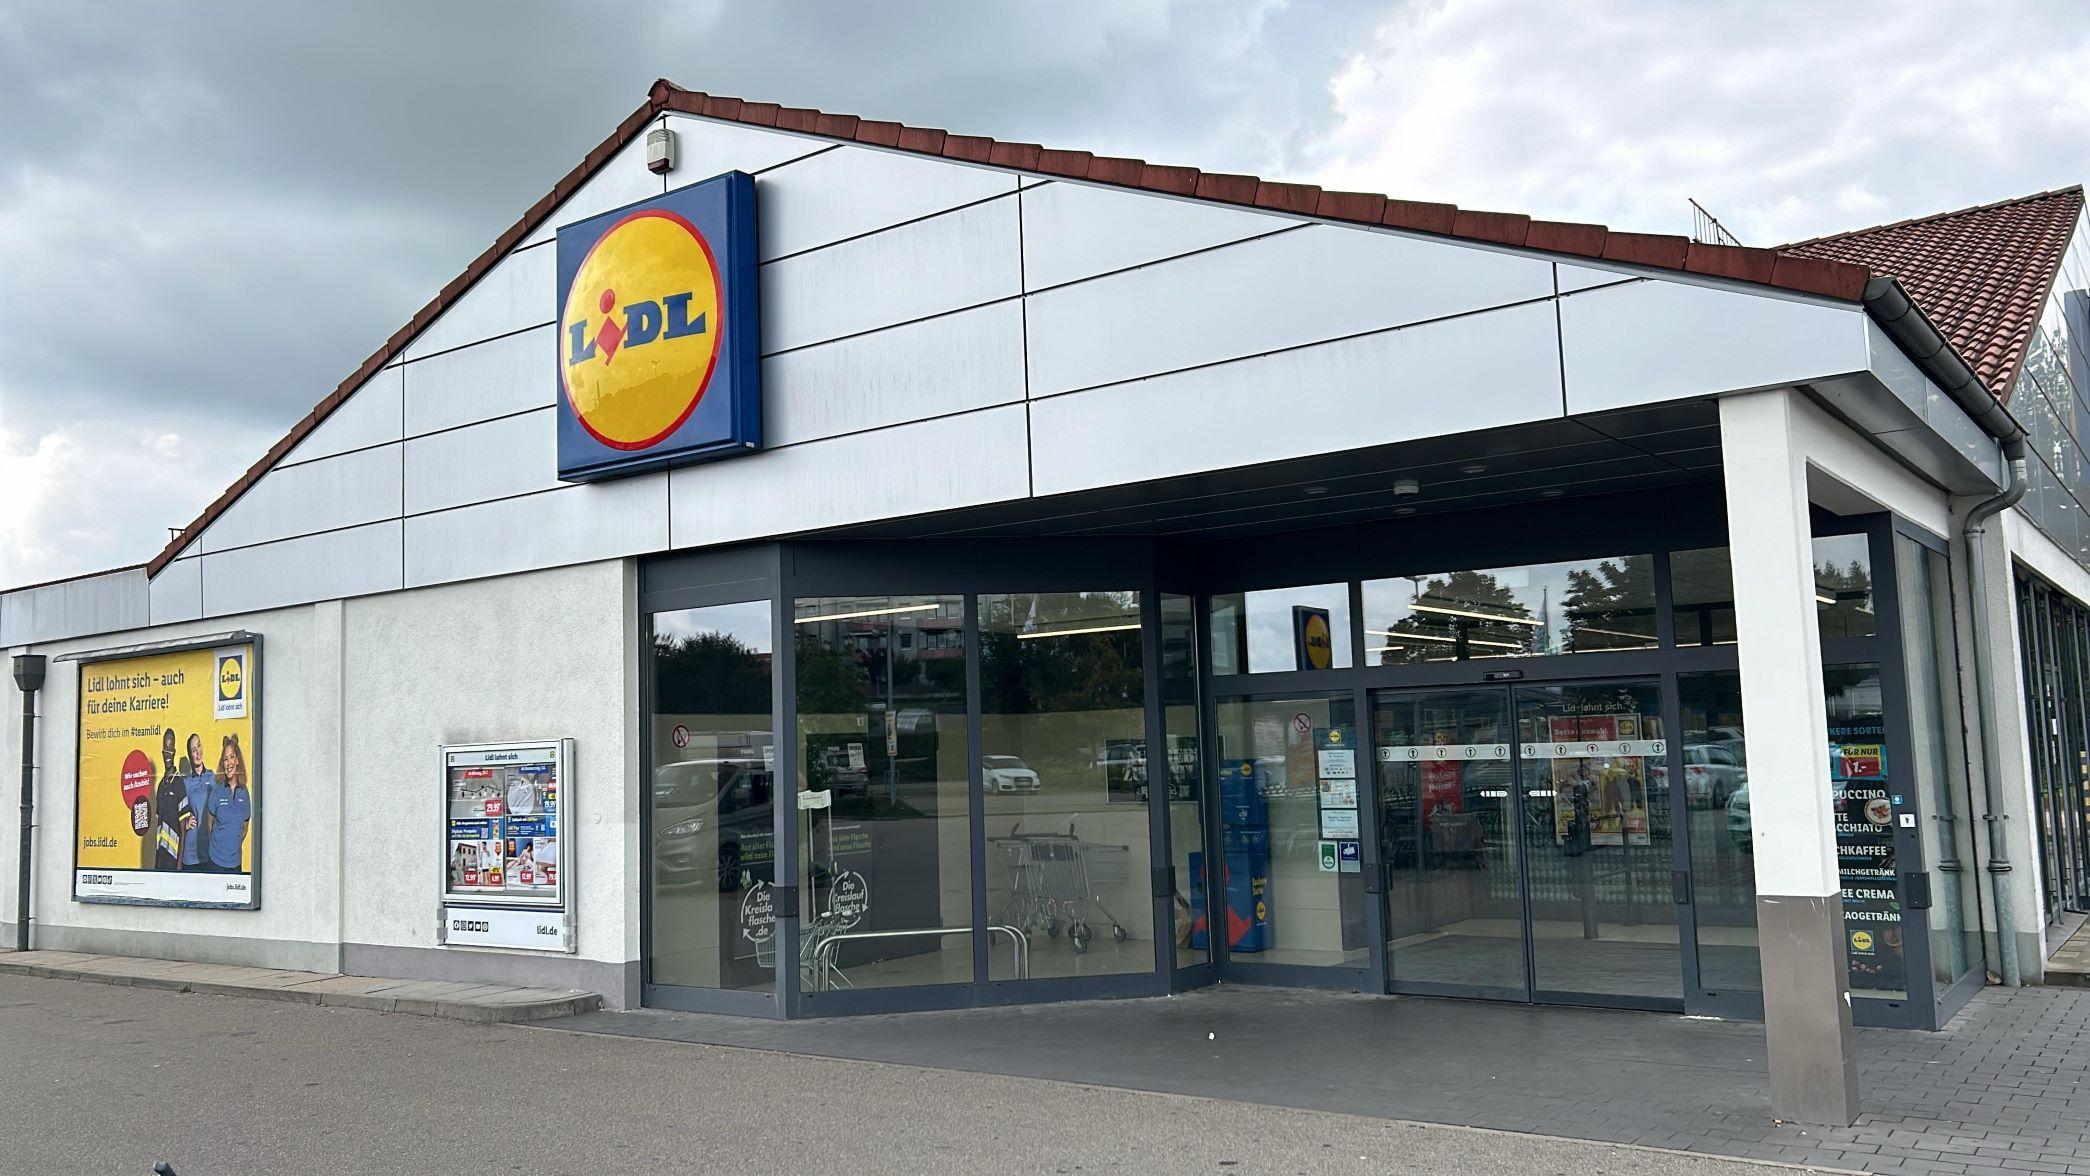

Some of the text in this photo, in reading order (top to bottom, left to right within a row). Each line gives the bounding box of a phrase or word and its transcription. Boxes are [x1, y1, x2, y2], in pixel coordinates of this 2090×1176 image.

[88, 676, 104, 692] Lidl
[107, 675, 130, 691] lohnt
[132, 672, 151, 689] sich
[161, 669, 184, 686] auch
[87, 694, 169, 714] für deine Karriere!
[86, 725, 161, 740] Bewirb dich im #teamlidl
[1861, 747, 1878, 756] NUR
[83, 836, 118, 850] jobs.lidl.de
[843, 880, 855, 891] Die
[757, 891, 770, 902] Die
[1842, 888, 1896, 900] EE CREMA
[749, 913, 776, 926] flasche
[536, 925, 558, 936] lidl.de
